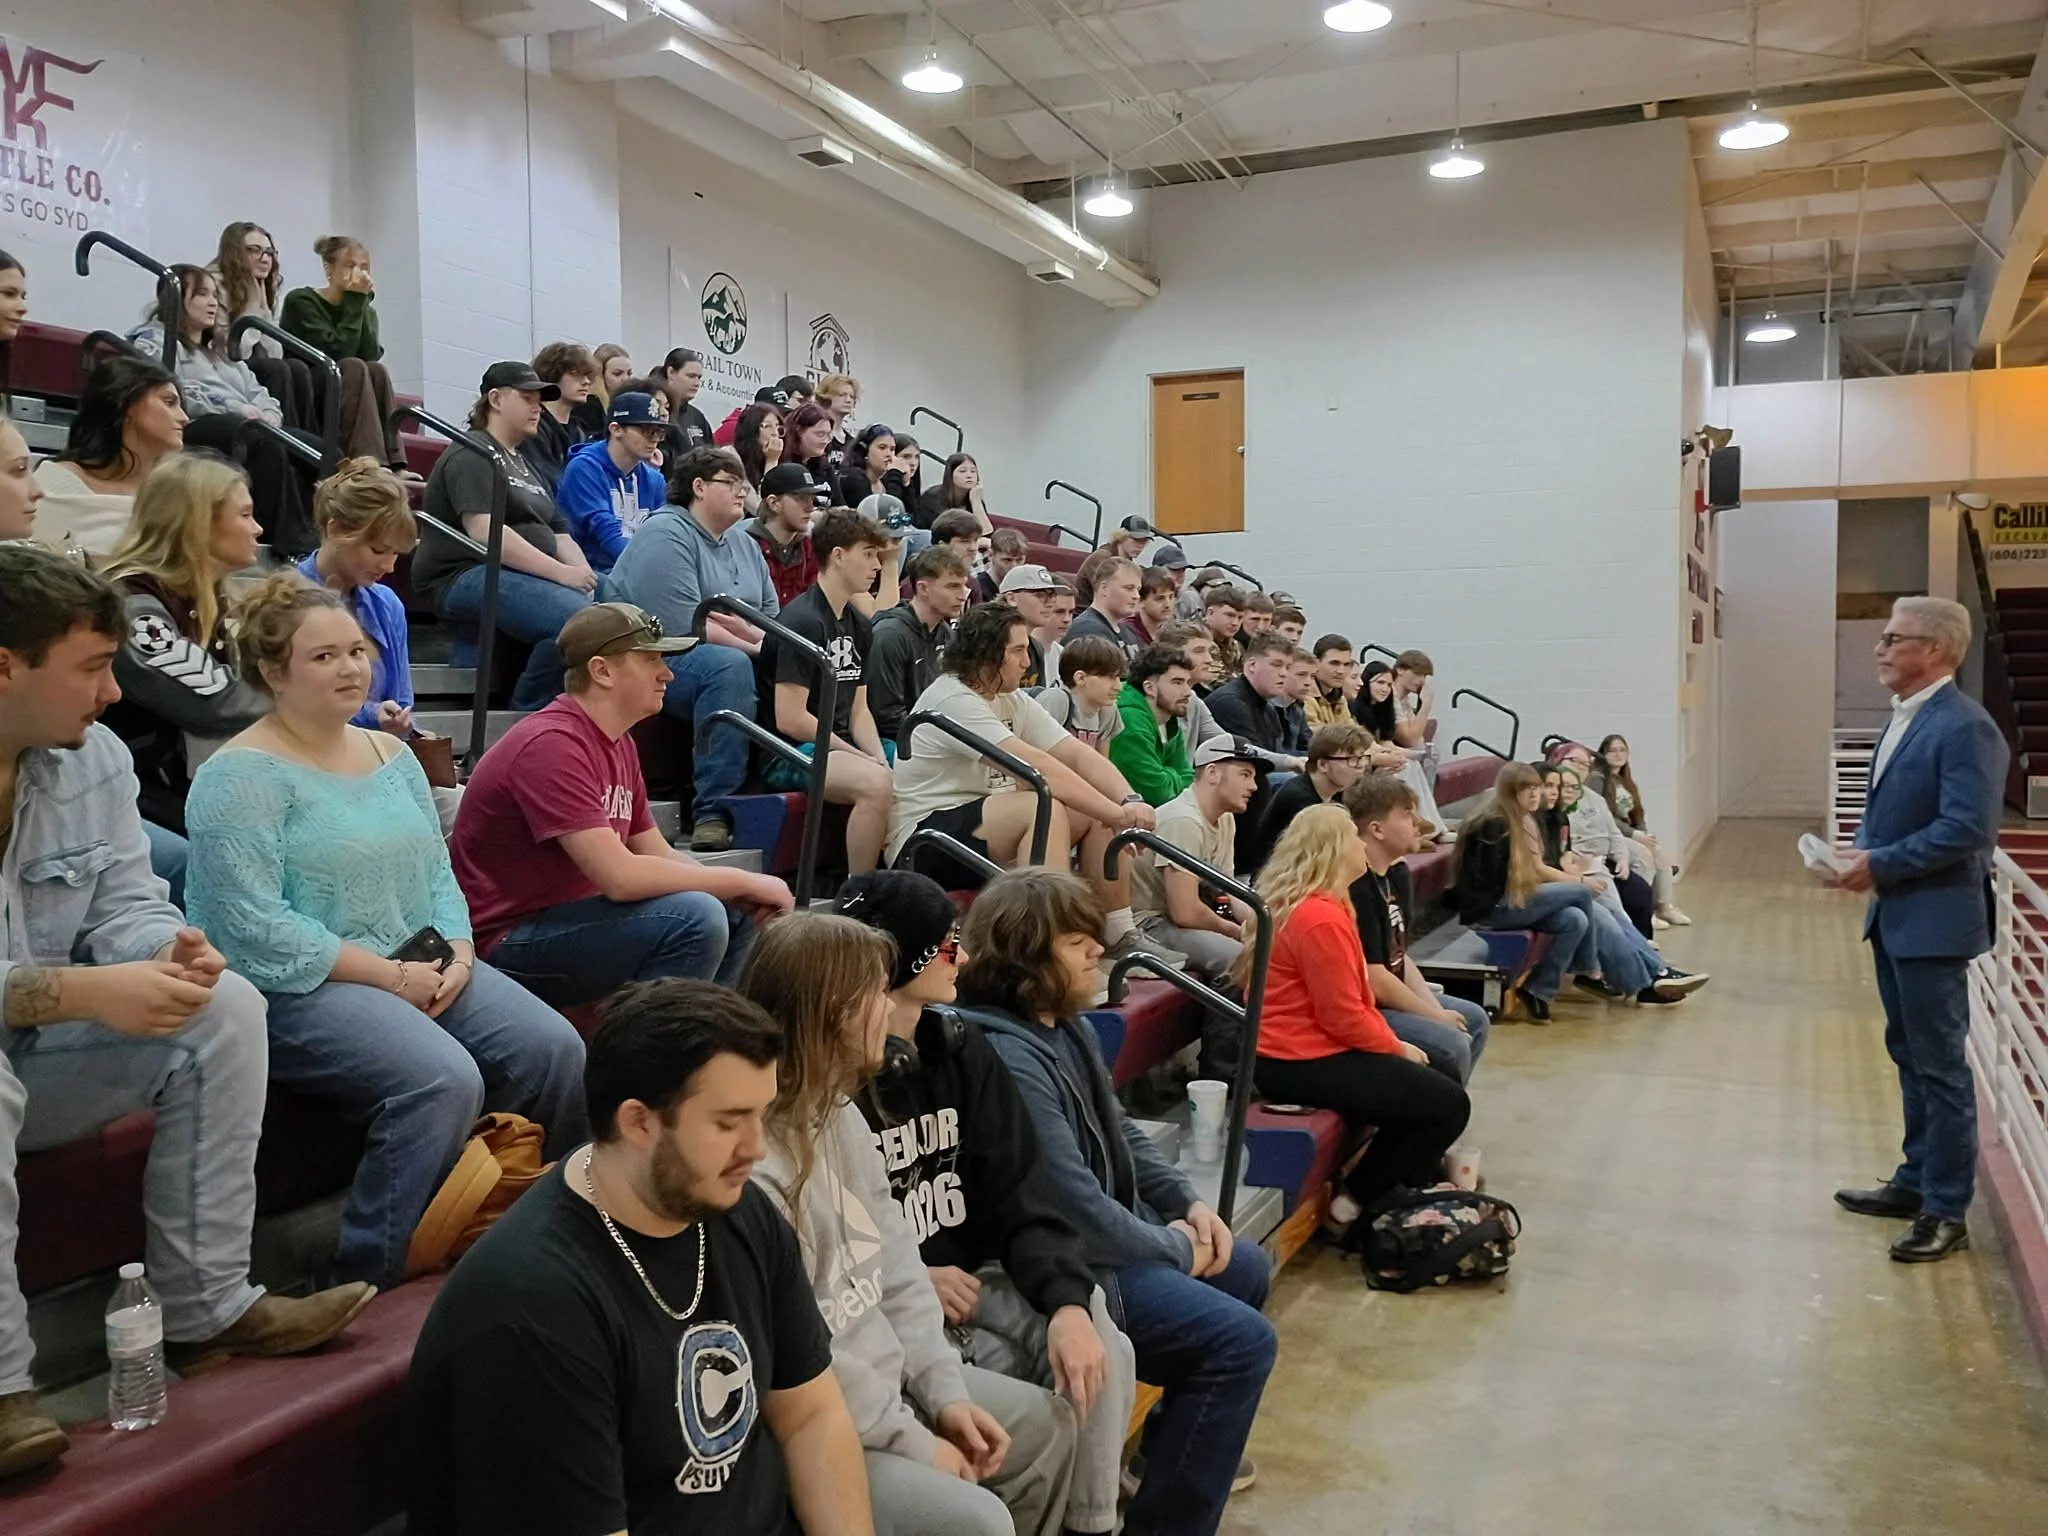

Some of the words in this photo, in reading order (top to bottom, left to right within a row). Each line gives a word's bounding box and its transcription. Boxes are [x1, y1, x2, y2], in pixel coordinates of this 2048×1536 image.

[65, 164, 110, 206] CO.
[21, 198, 48, 221] GO
[54, 206, 88, 231] SYD
[708, 378, 714, 391] &
[726, 360, 762, 384] TOWN
[898, 1171, 967, 1245] 026
